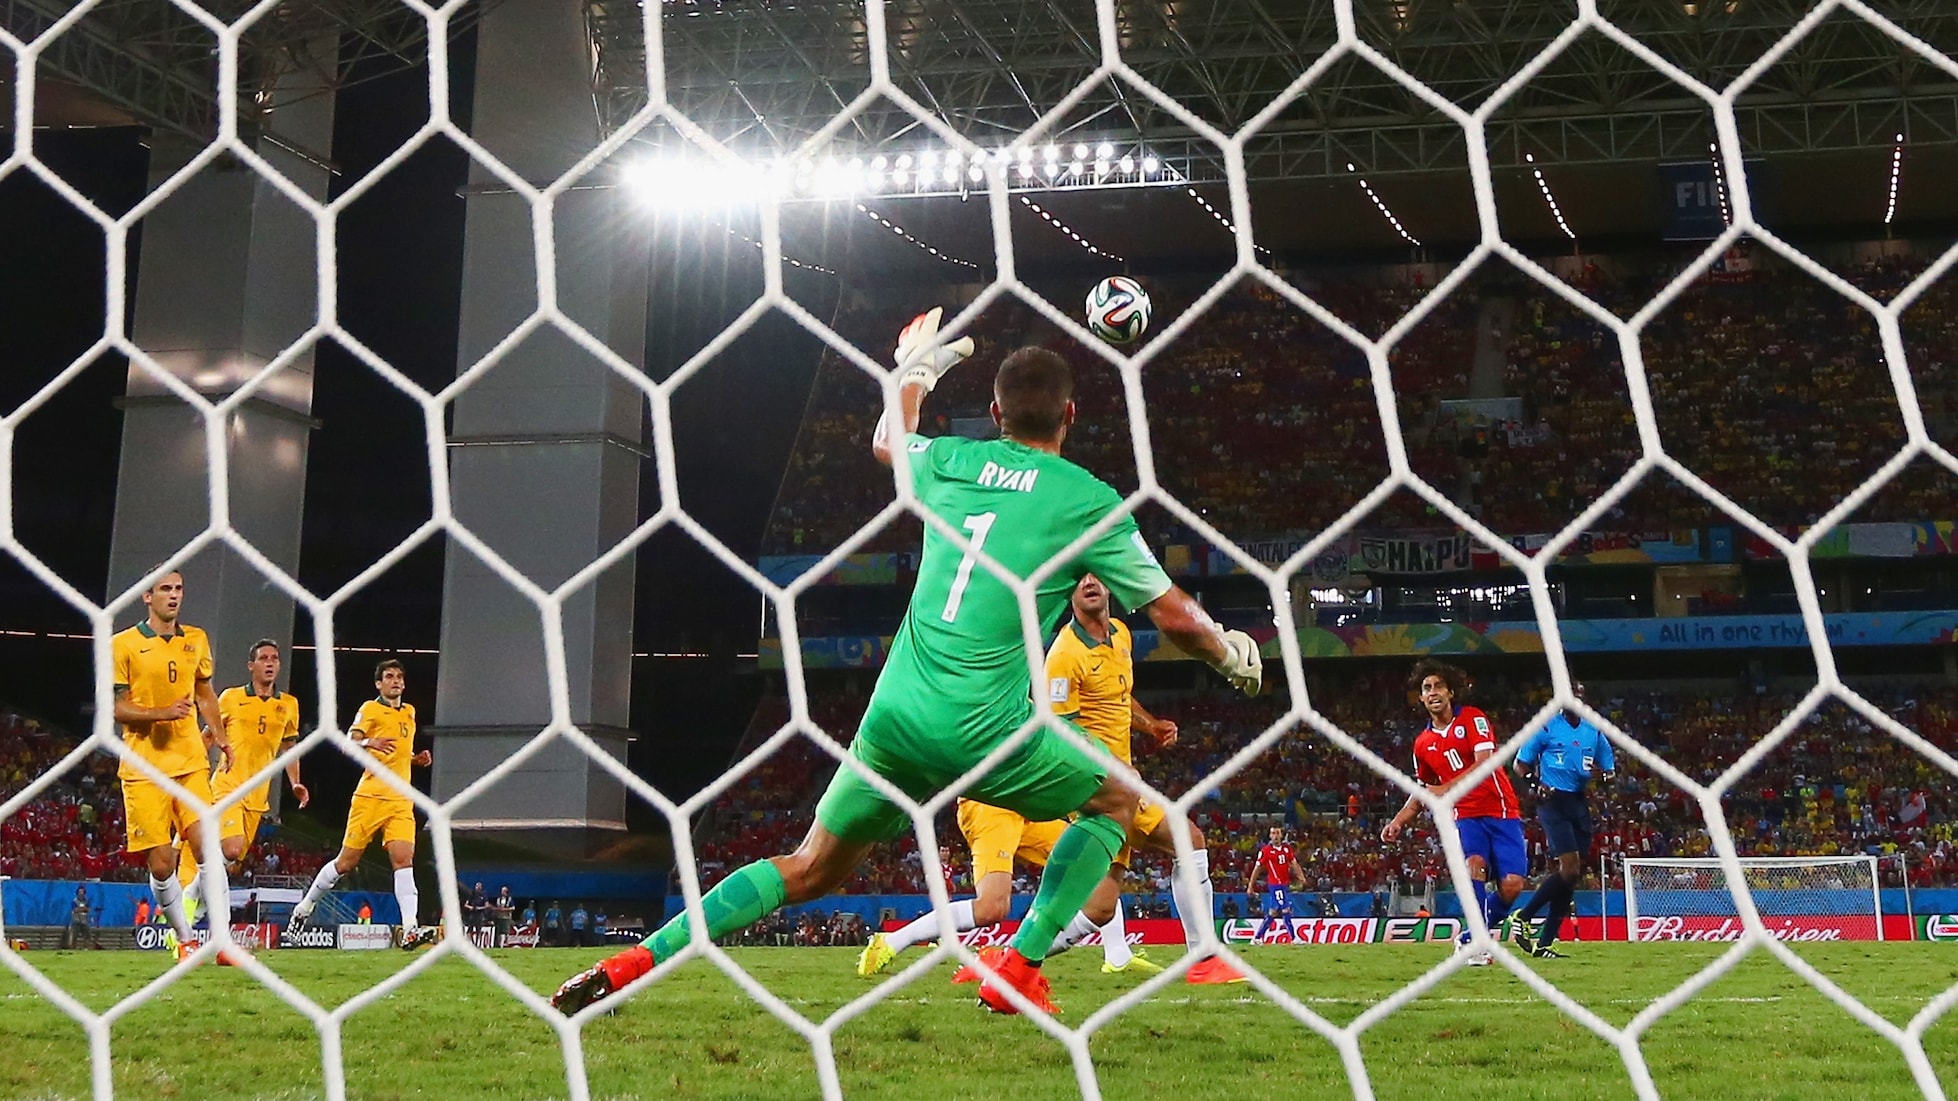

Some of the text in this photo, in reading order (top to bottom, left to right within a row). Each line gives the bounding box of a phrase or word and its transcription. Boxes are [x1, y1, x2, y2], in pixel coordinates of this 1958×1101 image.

[1676, 181, 1727, 208] FIF
[977, 461, 1039, 493] RYAN
[941, 511, 997, 624] 1
[1659, 620, 1843, 645] All in one rhym
[168, 660, 177, 683] 6
[258, 715, 267, 735] 5
[398, 721, 409, 738] 15
[1443, 748, 1464, 772] 10
